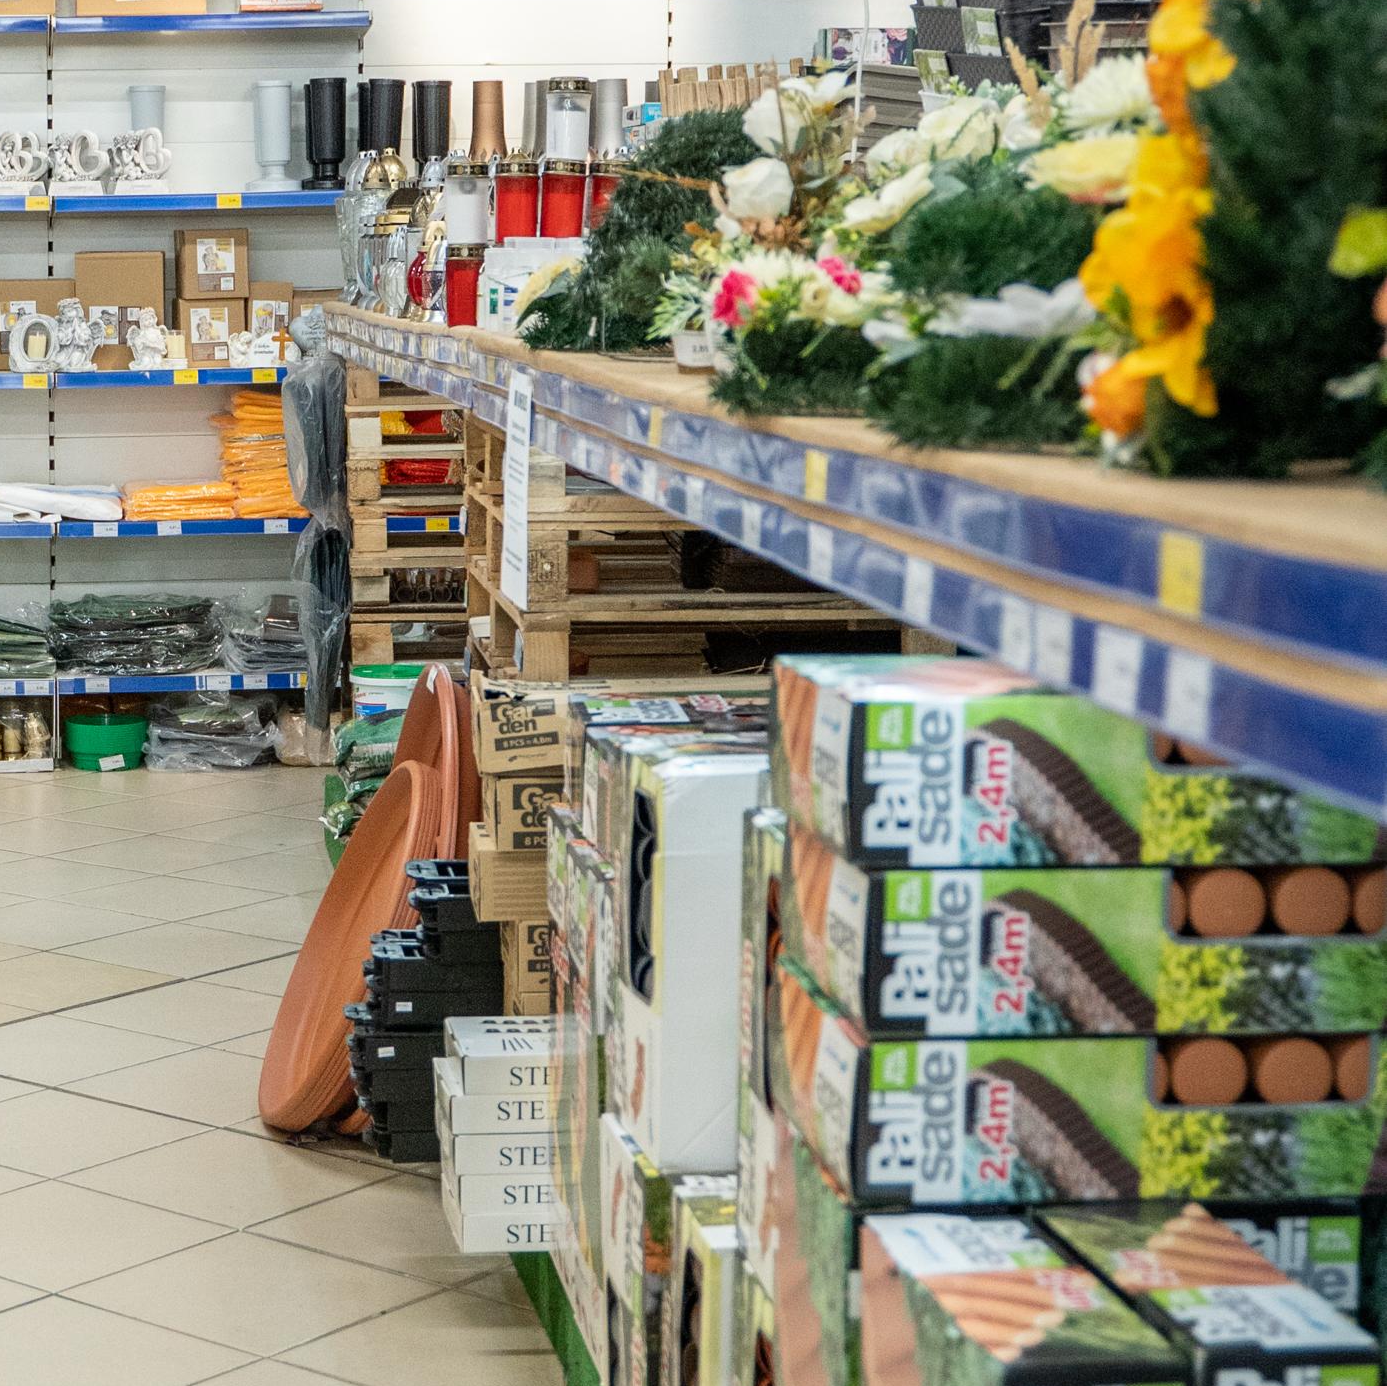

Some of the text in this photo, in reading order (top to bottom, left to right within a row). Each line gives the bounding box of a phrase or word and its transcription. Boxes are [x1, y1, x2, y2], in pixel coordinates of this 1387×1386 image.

[499, 718, 538, 734] den
[520, 787, 564, 810] Ga
[520, 805, 549, 828] de
[917, 710, 955, 847] sade
[978, 741, 1012, 845] 2,4m
[935, 879, 974, 1017] sade
[994, 913, 1028, 1015] 2,4m
[919, 1048, 958, 1184] sade
[979, 1082, 1012, 1181] 2,4m
